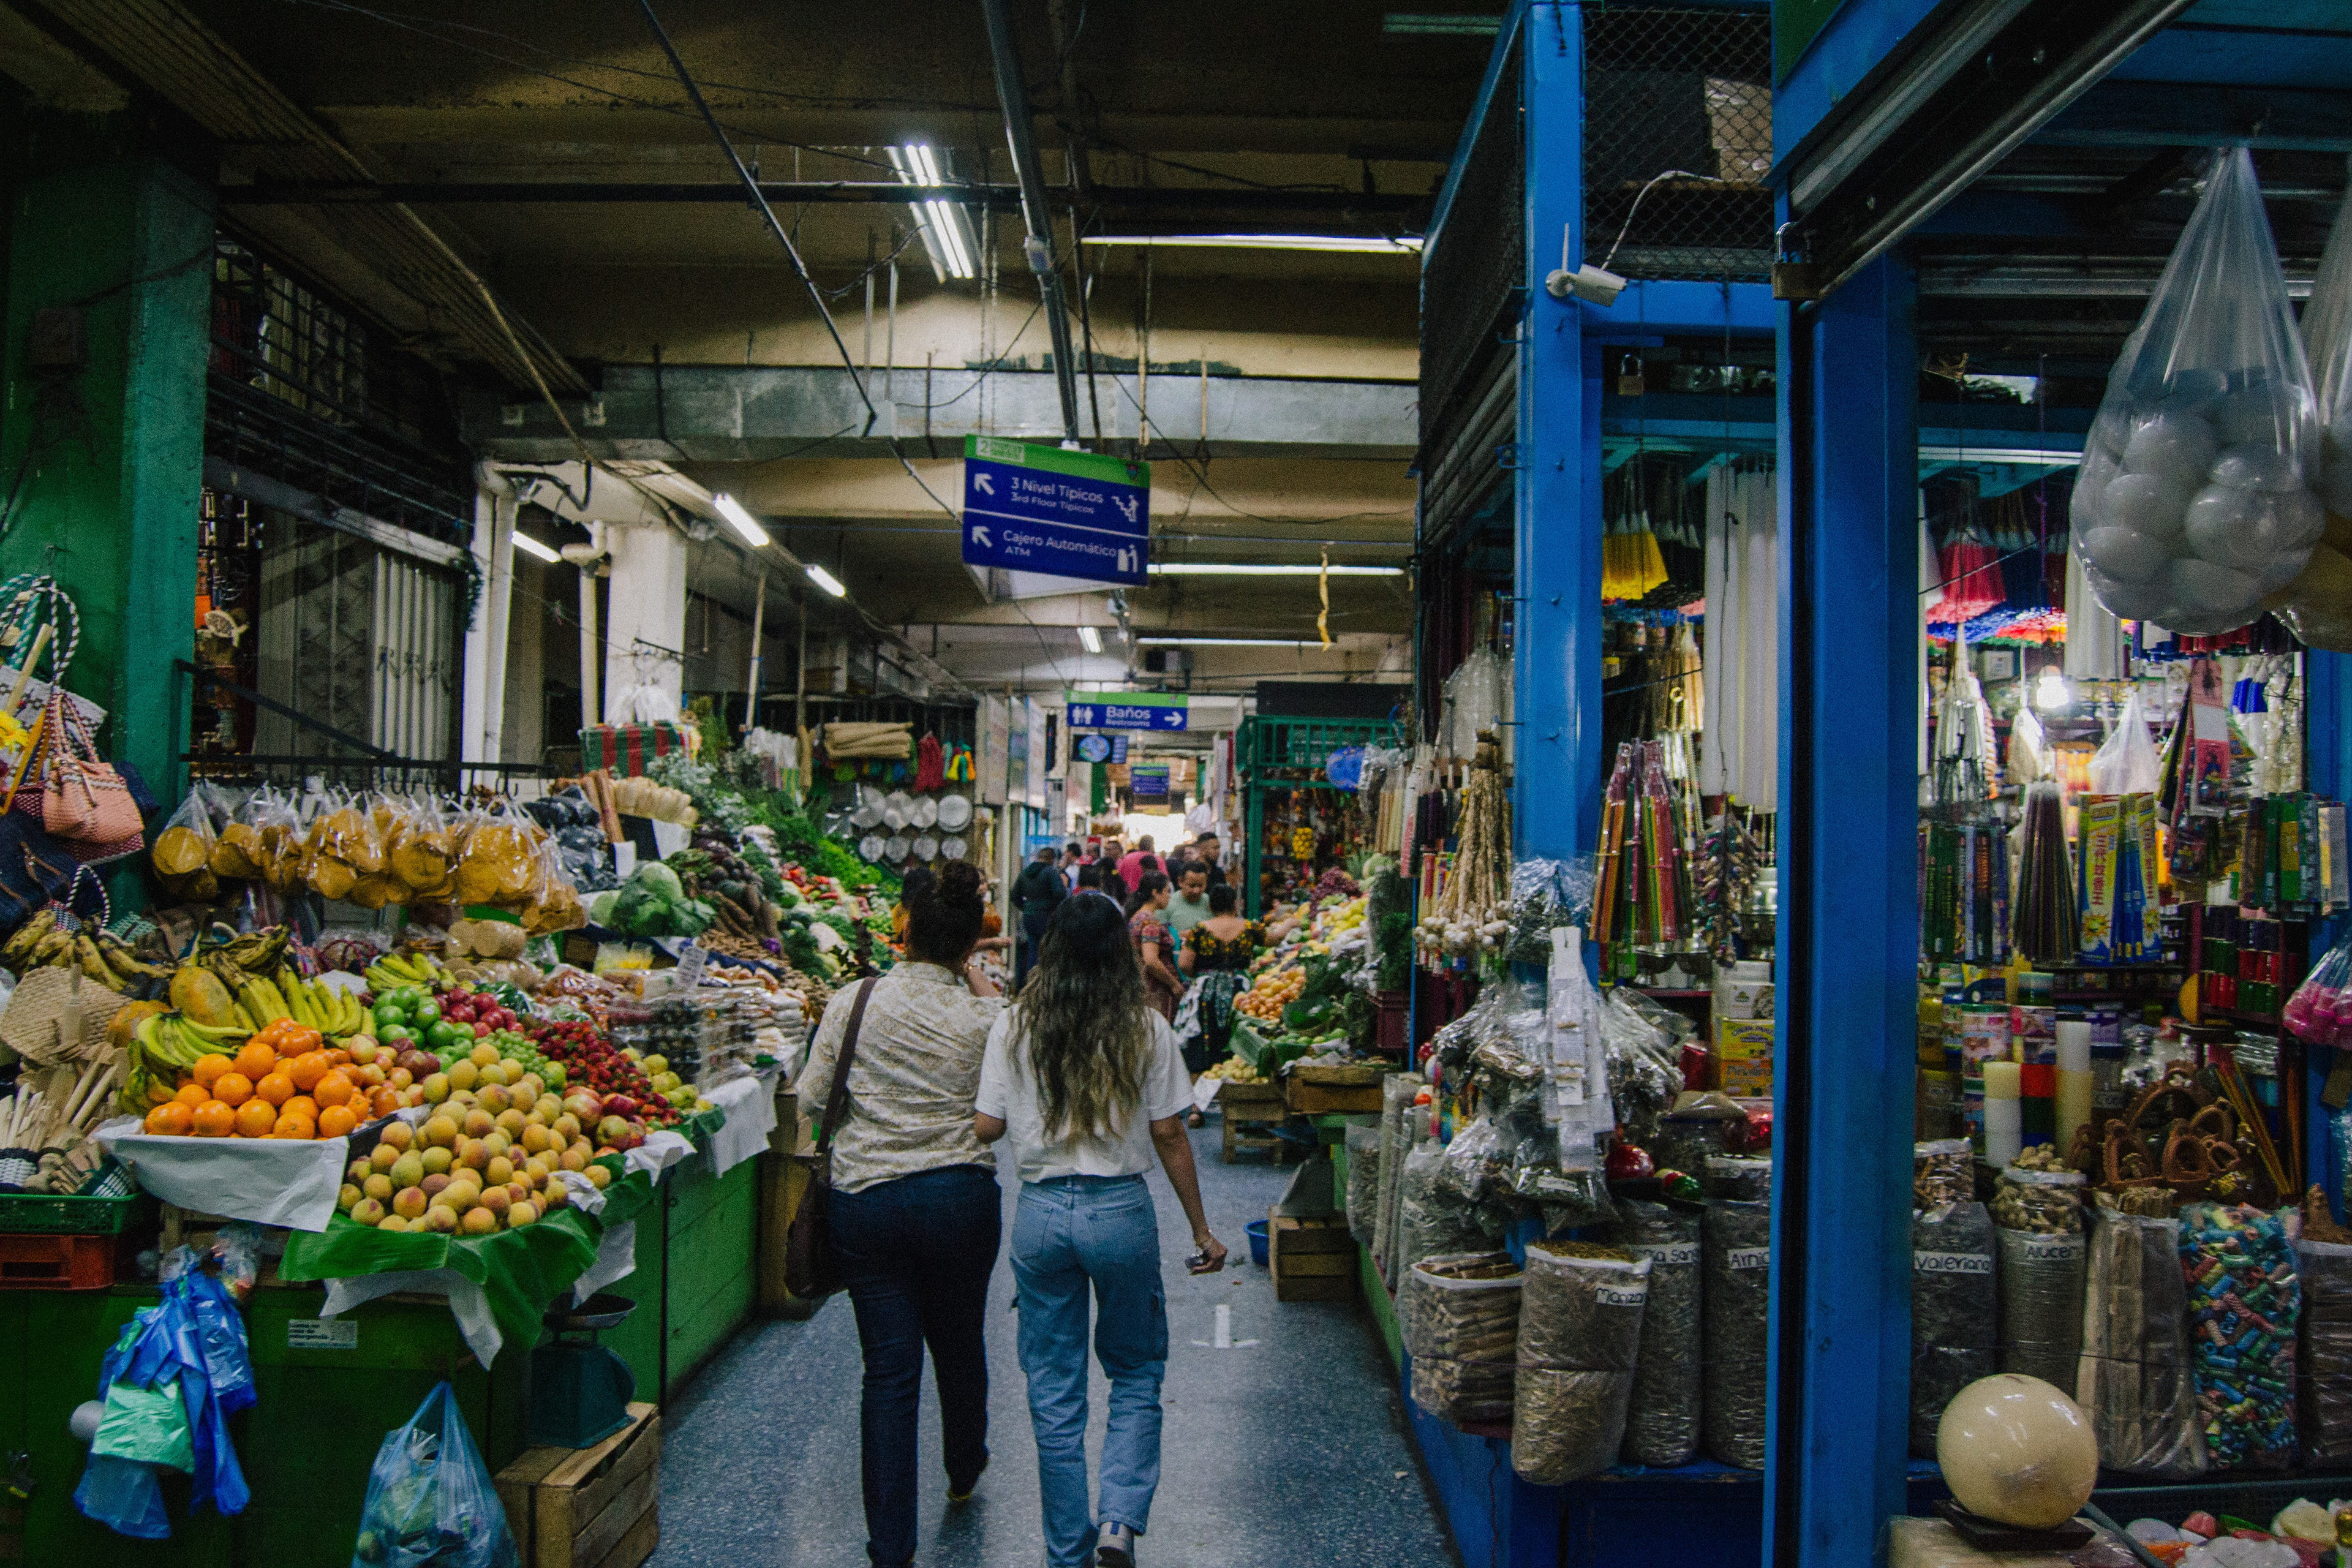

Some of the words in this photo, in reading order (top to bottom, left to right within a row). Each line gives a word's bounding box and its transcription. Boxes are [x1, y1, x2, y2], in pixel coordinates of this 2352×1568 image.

[1011, 477, 1019, 489] 3
[1023, 479, 1055, 495] Nivel
[1011, 492, 1029, 503] 3rd
[1031, 497, 1057, 508] Floor
[1003, 530, 1044, 546] Cajero
[1005, 546, 1030, 557] ATM
[1106, 706, 1152, 720] Baños
[1731, 1251, 1770, 1267] Arnic
